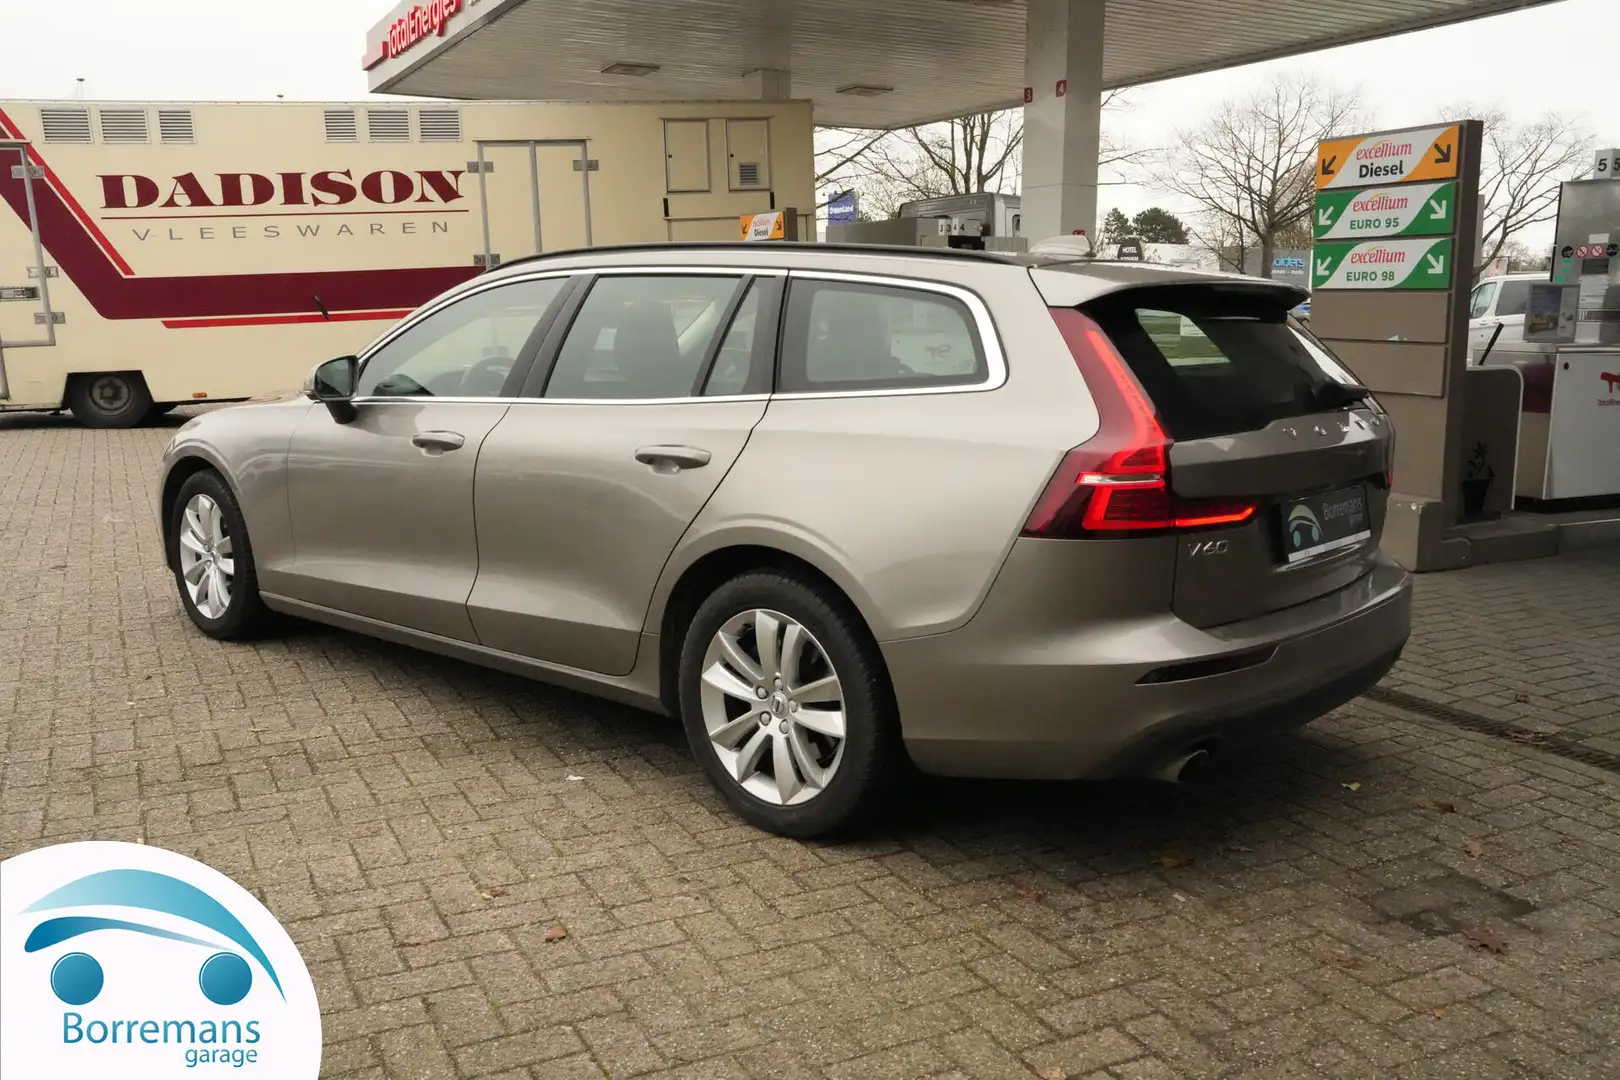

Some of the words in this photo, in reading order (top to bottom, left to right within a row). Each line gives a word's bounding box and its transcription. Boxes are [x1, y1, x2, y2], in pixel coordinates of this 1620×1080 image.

[1356, 140, 1413, 161] excellium
[1359, 160, 1404, 178] Diesel
[1598, 158, 1607, 171] 5
[96, 168, 467, 209] DADISON
[1352, 193, 1408, 213] excellium
[131, 221, 449, 241] VLEESWAREN
[1349, 219, 1381, 230] EURO
[1384, 217, 1399, 228] 95
[1351, 246, 1406, 265] excellium
[1346, 271, 1378, 282] EURO
[1381, 270, 1396, 281] 98
[1188, 540, 1229, 557] V60
